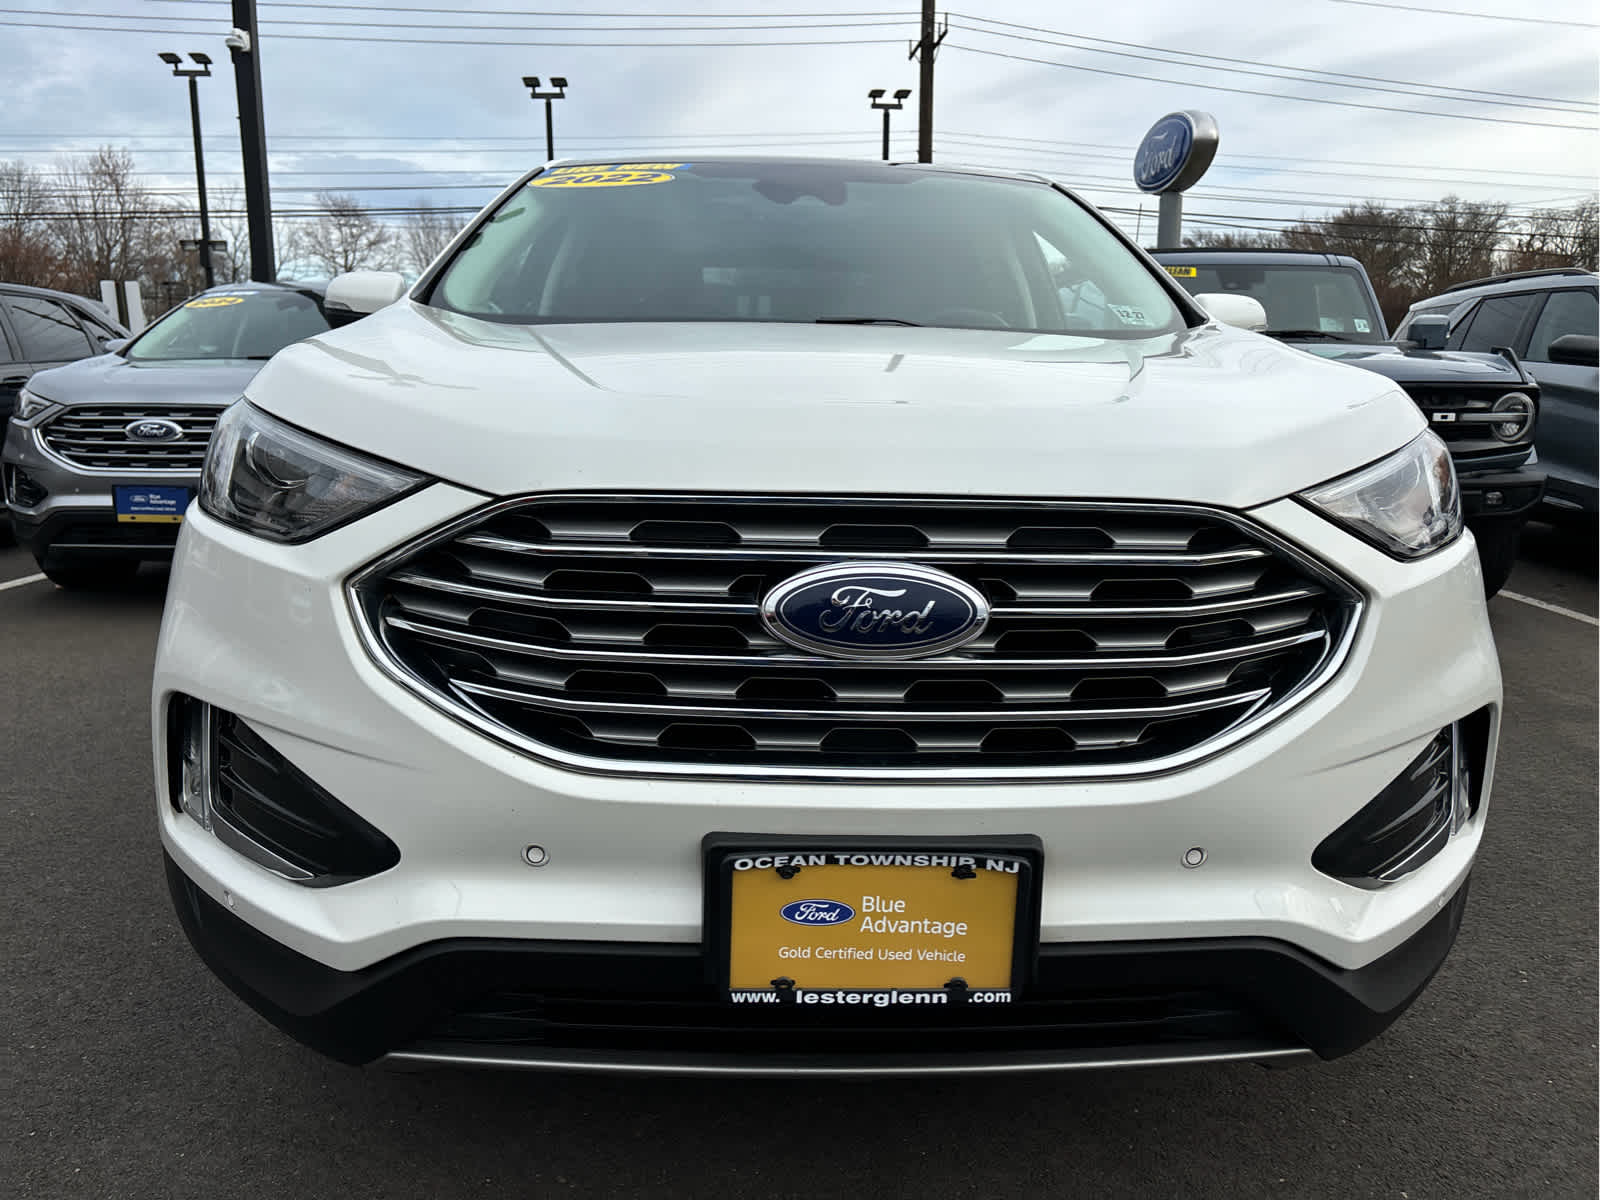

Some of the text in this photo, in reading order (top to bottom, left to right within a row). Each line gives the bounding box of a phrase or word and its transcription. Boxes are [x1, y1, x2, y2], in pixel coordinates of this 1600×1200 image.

[1140, 130, 1178, 181] Ford
[542, 173, 662, 185] 2022
[137, 423, 167, 437] Ford
[818, 585, 936, 635] Ford
[733, 855, 827, 872] OCEAN
[985, 858, 1020, 874] NJ
[794, 902, 841, 922] Ford
[861, 895, 906, 913] Blue
[860, 915, 968, 938] Advantage
[778, 946, 966, 962] Gold Certified Used Vehicle
[731, 989, 1012, 1008] www. lesterglenn .com
